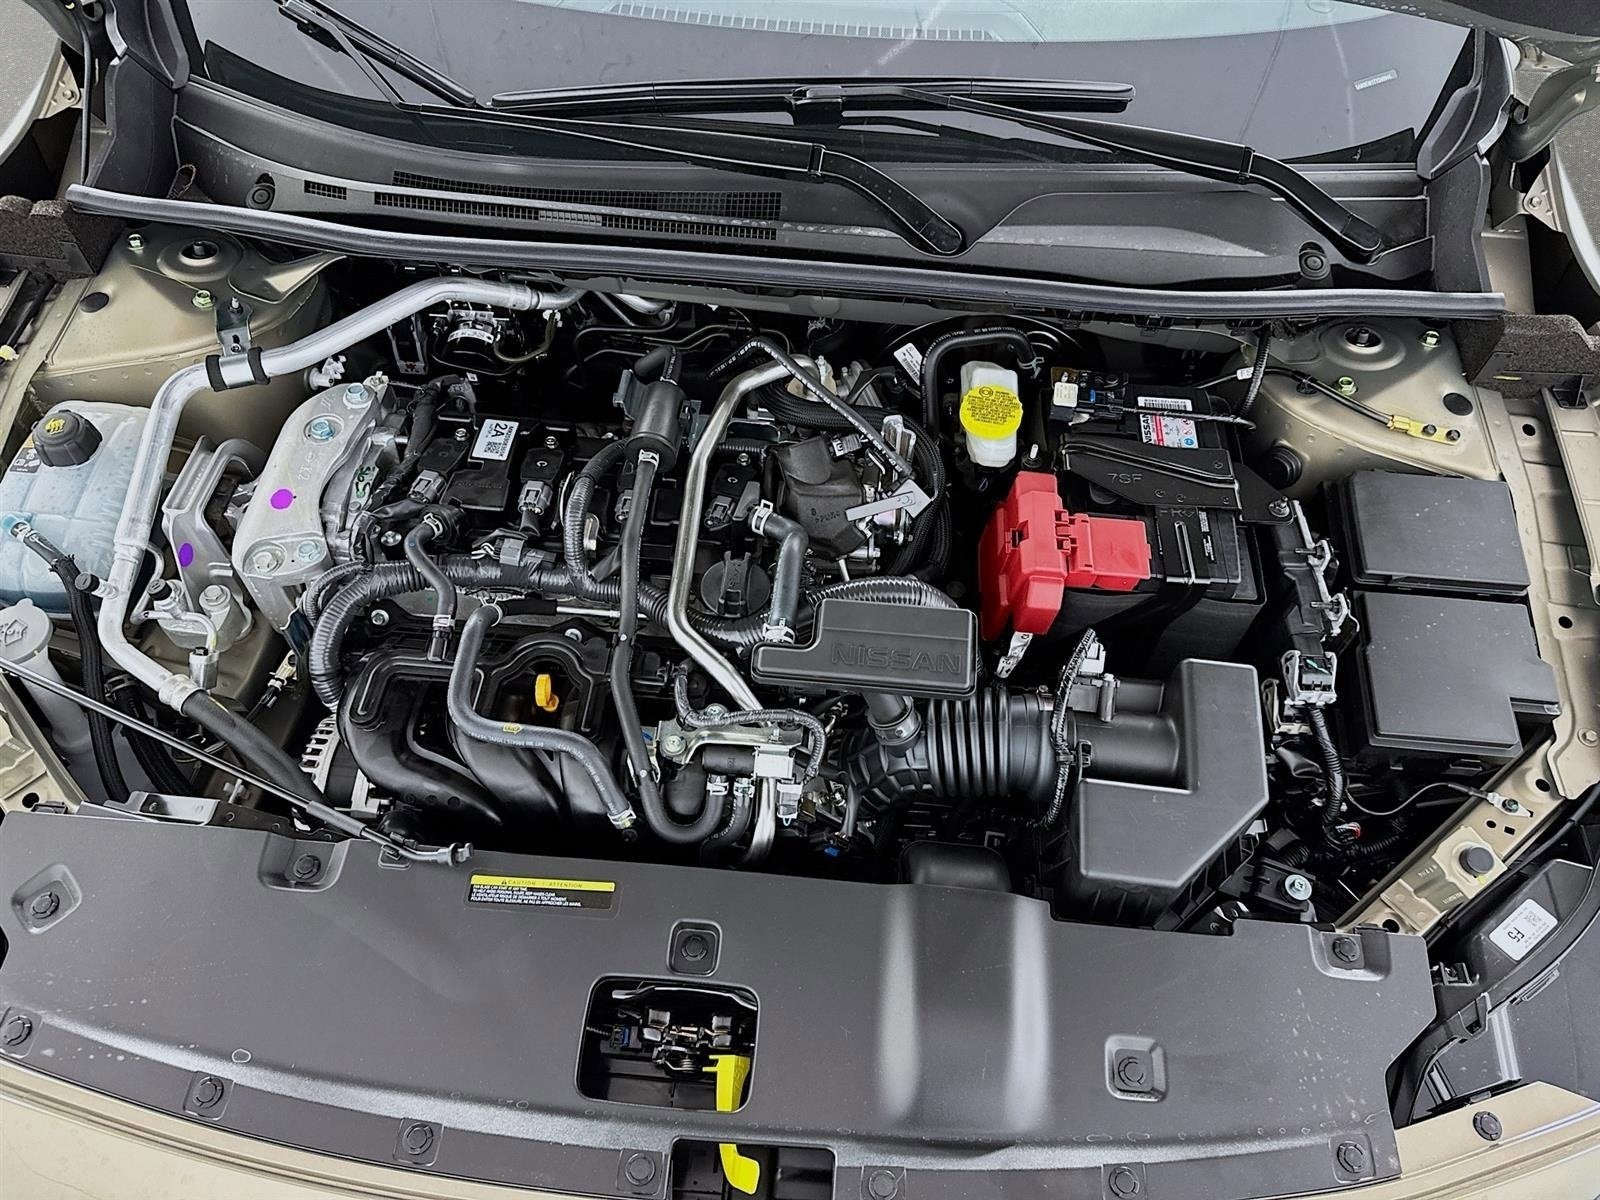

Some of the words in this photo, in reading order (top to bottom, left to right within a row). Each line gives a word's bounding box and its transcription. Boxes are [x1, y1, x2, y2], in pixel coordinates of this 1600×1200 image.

[491, 423, 508, 438] 2A
[1107, 473, 1143, 484] 7SF
[832, 643, 962, 674] NISSAN
[1507, 927, 1525, 943] F5
